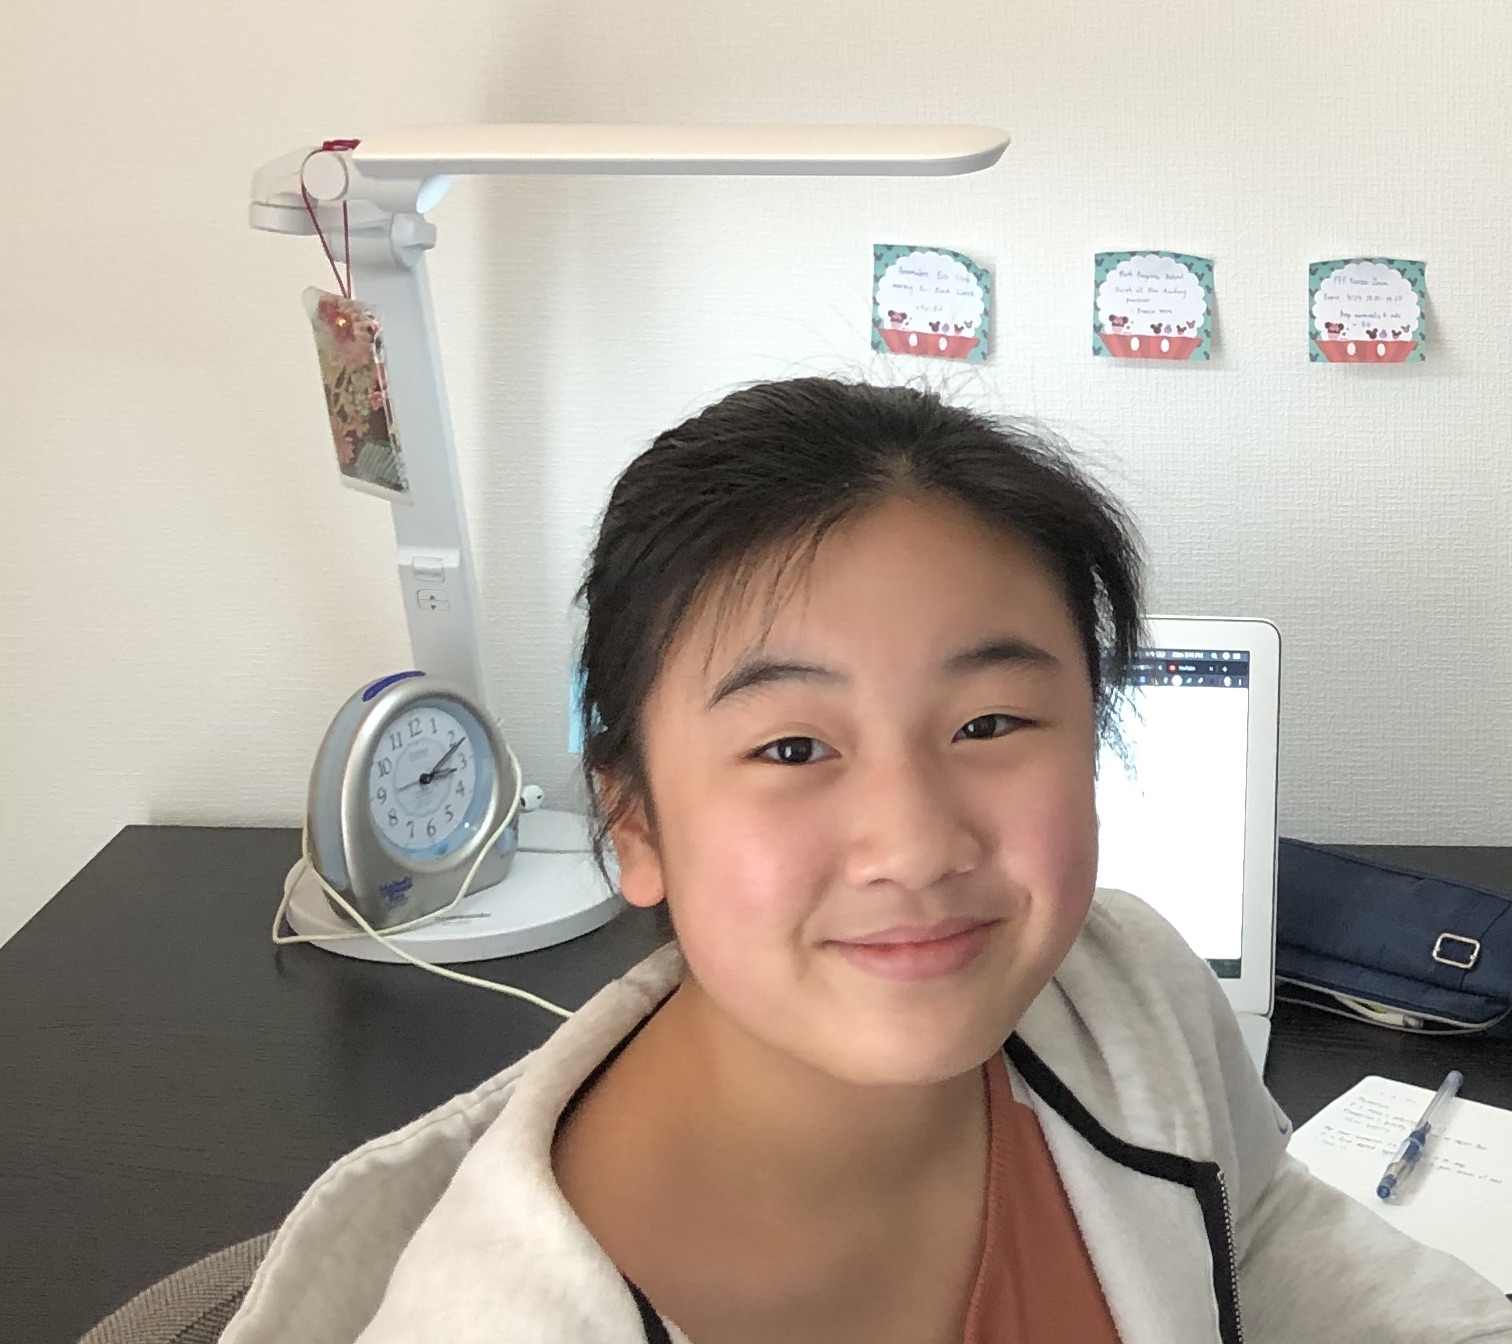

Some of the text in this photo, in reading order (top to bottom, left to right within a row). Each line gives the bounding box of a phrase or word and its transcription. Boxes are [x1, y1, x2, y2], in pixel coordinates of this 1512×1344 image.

[408, 718, 423, 739] 12
[431, 717, 438, 735] 1
[390, 731, 403, 751] 11
[378, 757, 393, 778] 10
[458, 753, 468, 770] 3
[377, 787, 388, 805] 9
[456, 780, 466, 797] 4
[388, 808, 399, 827] 8
[445, 804, 455, 823] 5
[407, 821, 416, 839] 7
[426, 818, 437, 838] 6
